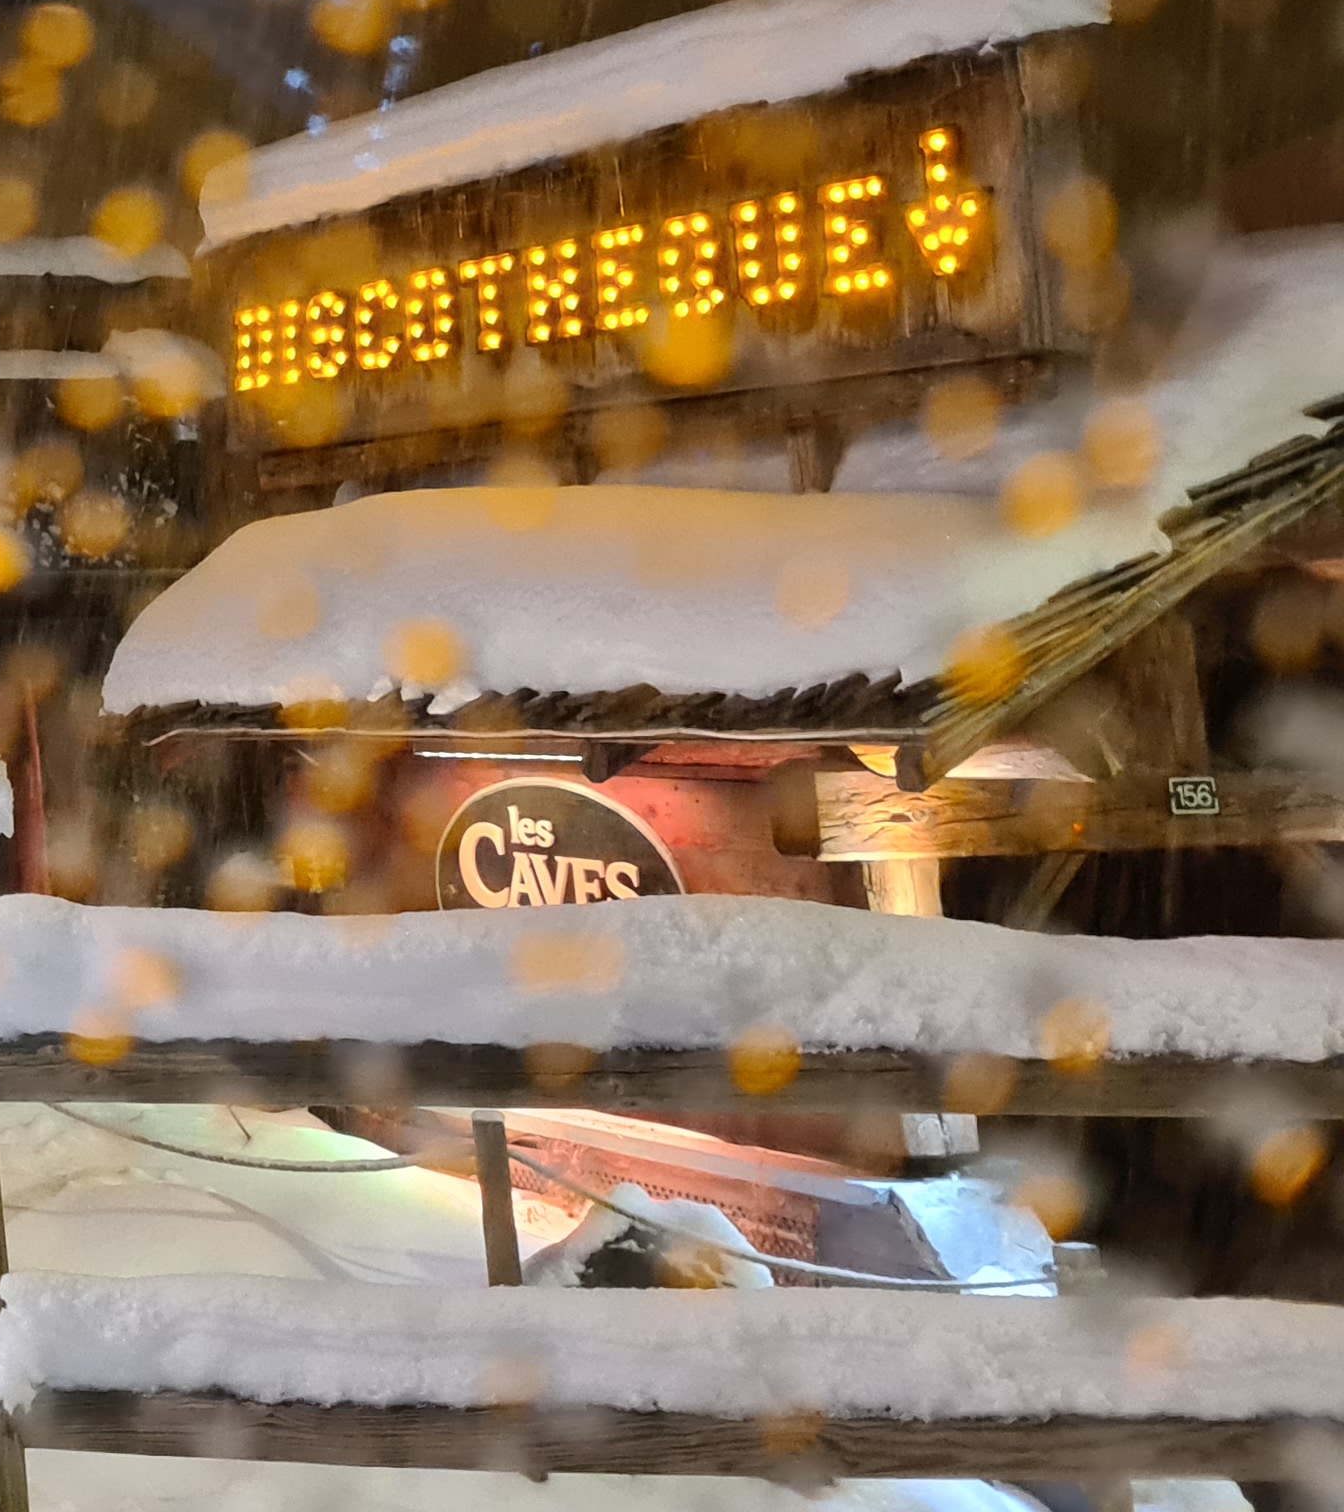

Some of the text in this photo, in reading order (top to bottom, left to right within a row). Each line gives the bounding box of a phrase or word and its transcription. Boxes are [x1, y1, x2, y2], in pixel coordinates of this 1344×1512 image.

[234, 174, 890, 392] DISCOTHEQUE
[1175, 783, 1213, 808] 156
[507, 804, 556, 848] les
